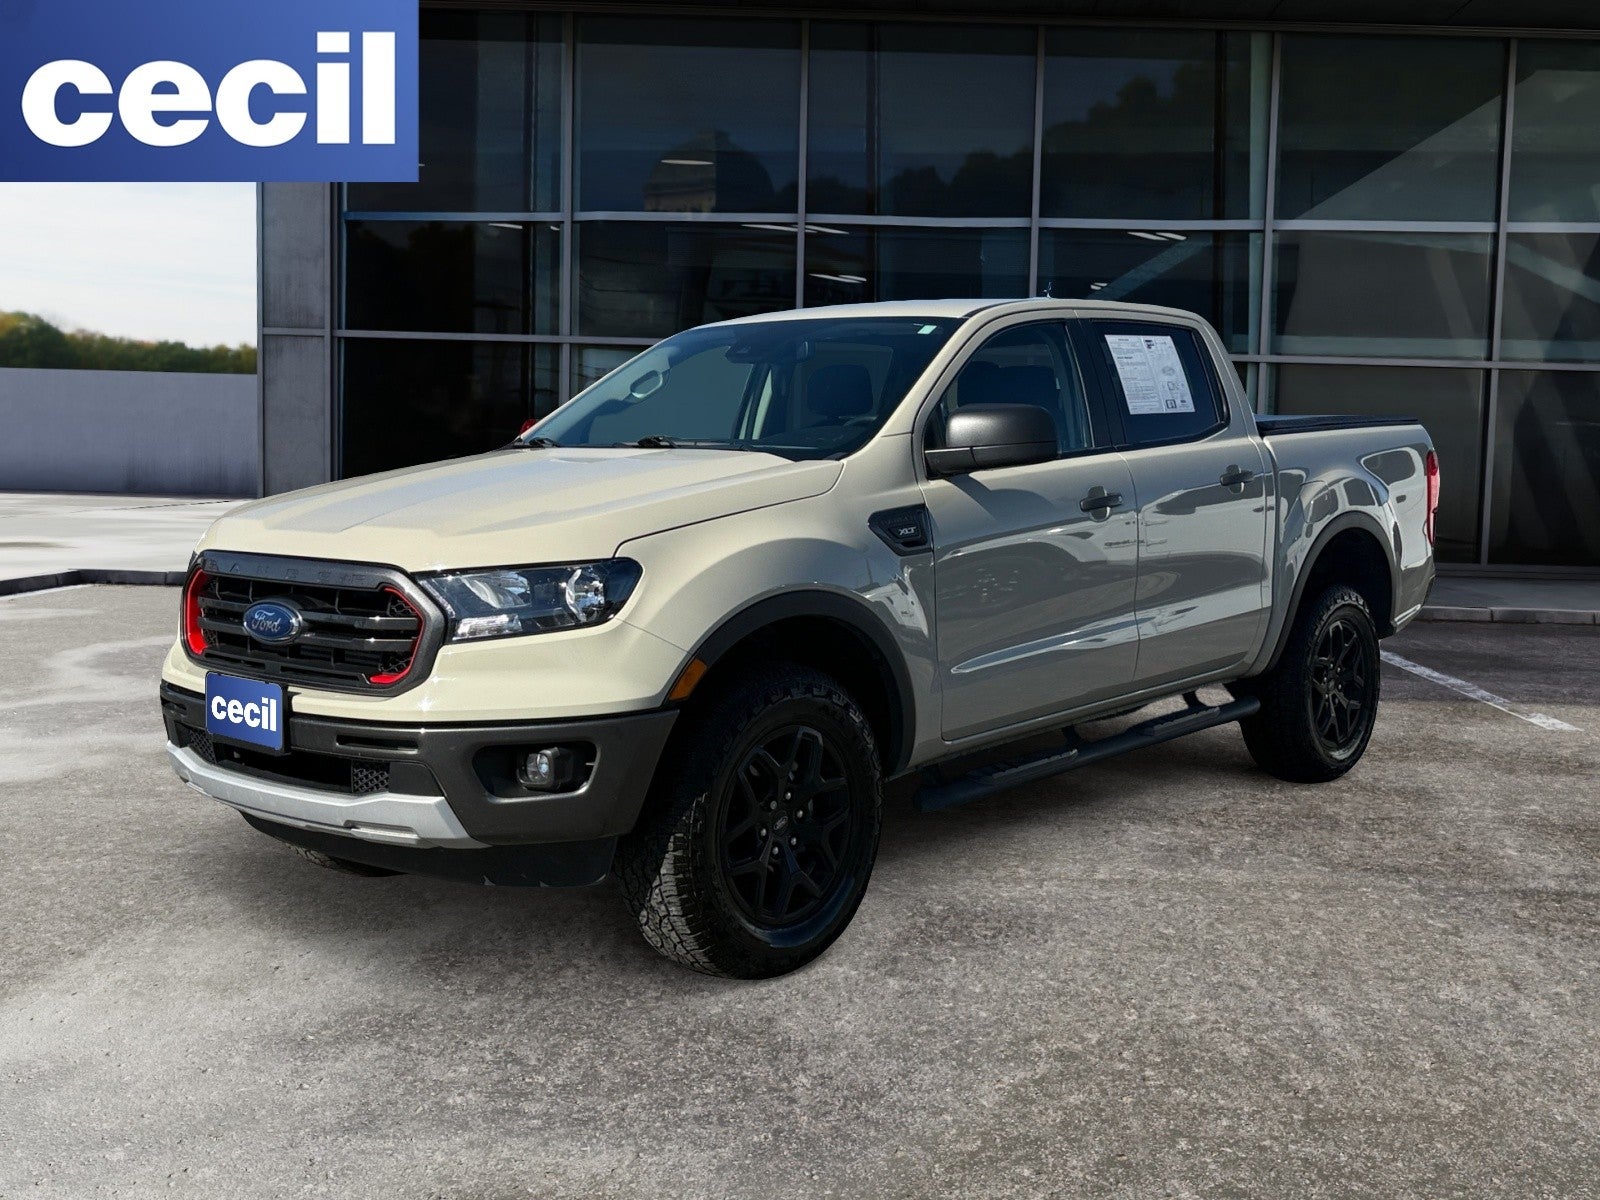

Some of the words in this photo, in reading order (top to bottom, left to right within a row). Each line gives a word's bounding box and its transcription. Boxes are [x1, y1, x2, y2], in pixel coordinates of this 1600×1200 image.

[899, 526, 916, 536] XLT
[251, 609, 281, 632] Ford
[211, 695, 277, 732] cecil
